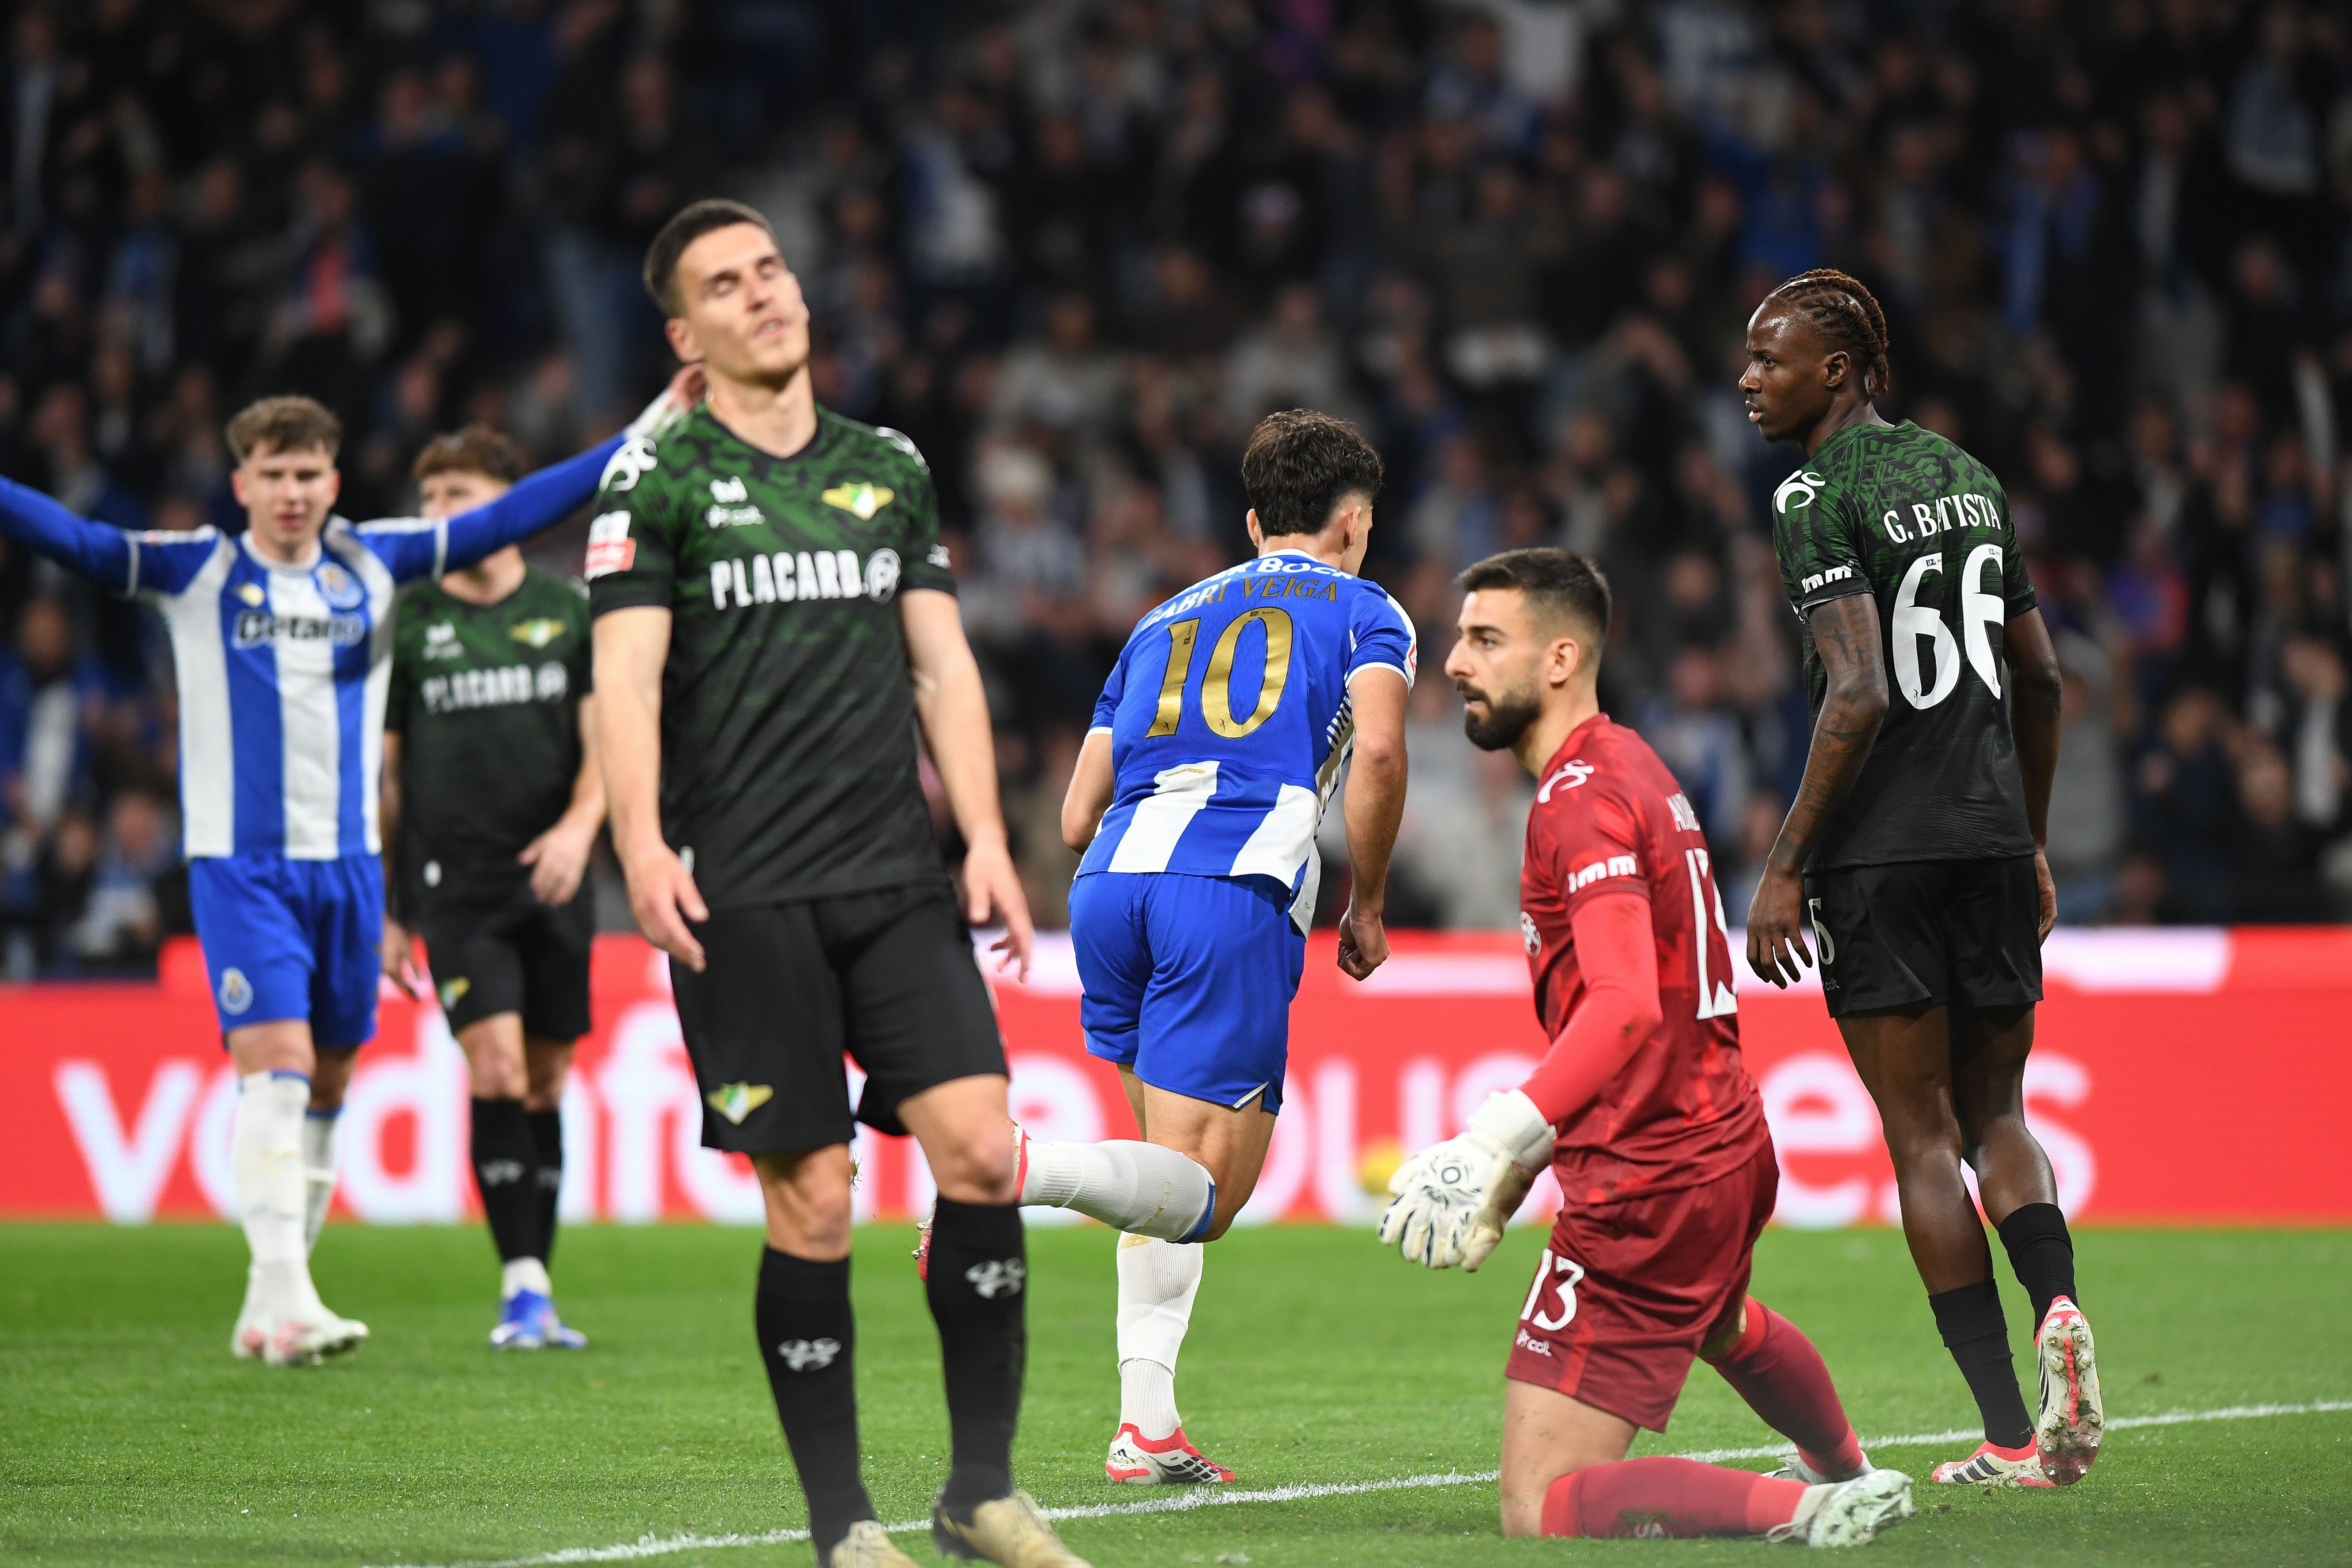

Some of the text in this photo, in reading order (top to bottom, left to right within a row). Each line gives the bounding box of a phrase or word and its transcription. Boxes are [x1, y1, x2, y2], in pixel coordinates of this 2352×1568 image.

[1884, 493, 2001, 544] G. BATISTA
[1242, 576, 1337, 602] VEIGA
[1892, 544, 2005, 710] 66
[1145, 606, 1294, 739] 10
[1519, 1248, 1585, 1331] 13
